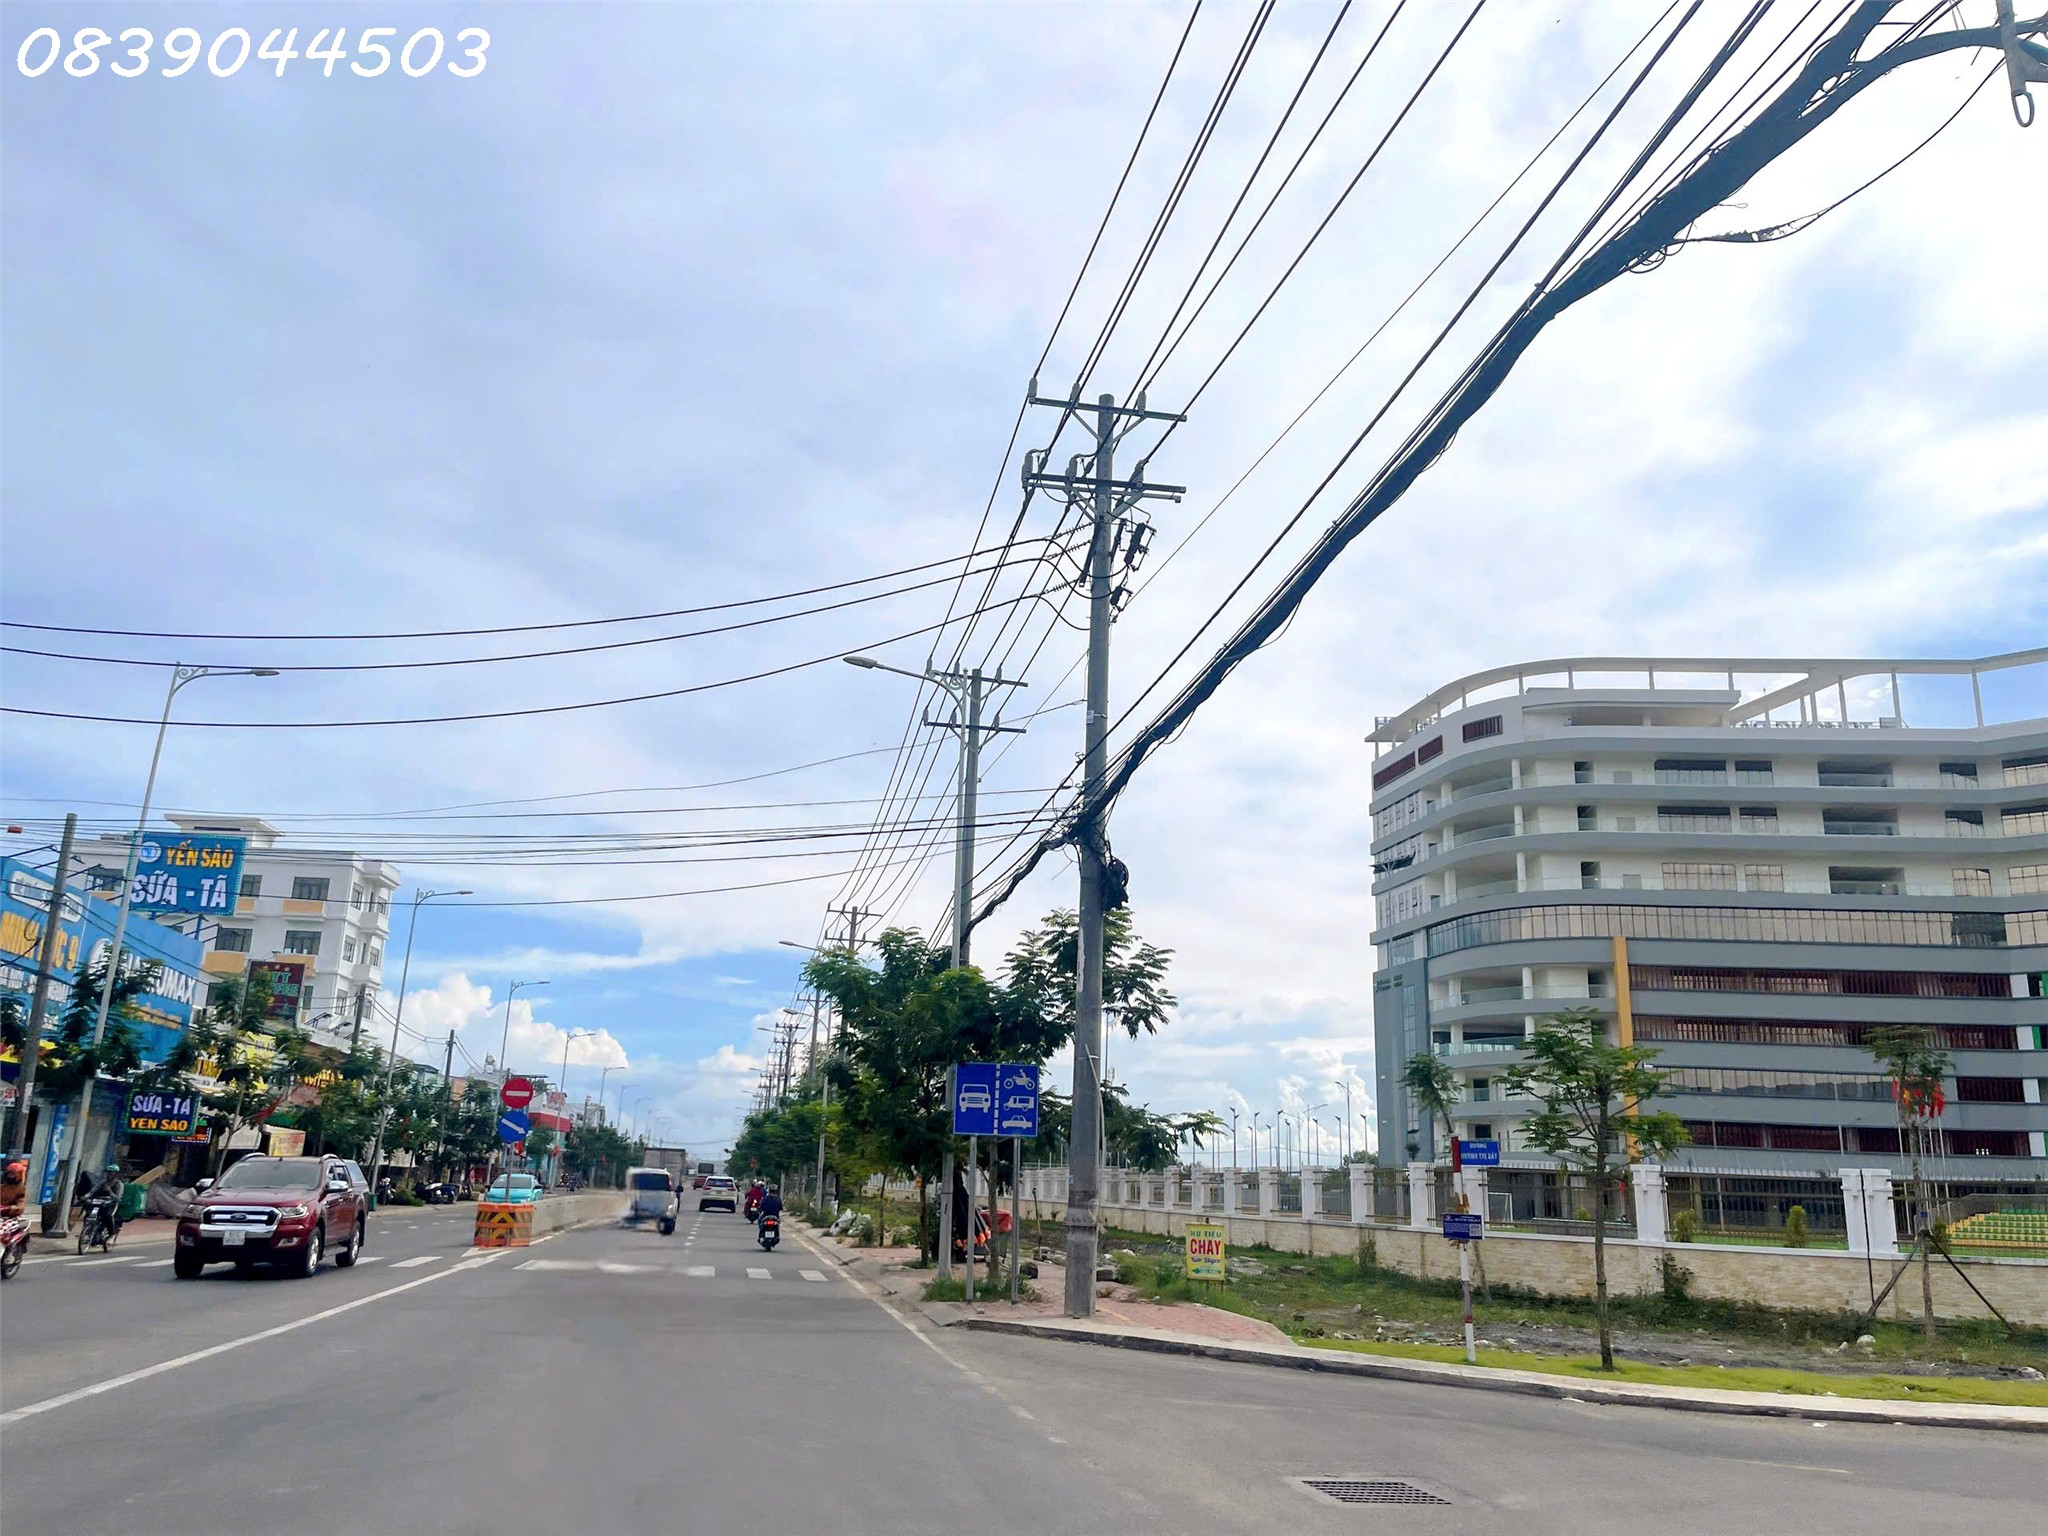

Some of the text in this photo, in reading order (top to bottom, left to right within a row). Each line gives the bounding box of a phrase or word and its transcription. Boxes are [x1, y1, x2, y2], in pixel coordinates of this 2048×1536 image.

[165, 839, 199, 867] YẾN
[200, 844, 234, 869] SÀO
[130, 870, 178, 905] SỮA
[200, 874, 228, 908] TÃ
[1190, 1238, 1222, 1256] CHAY
